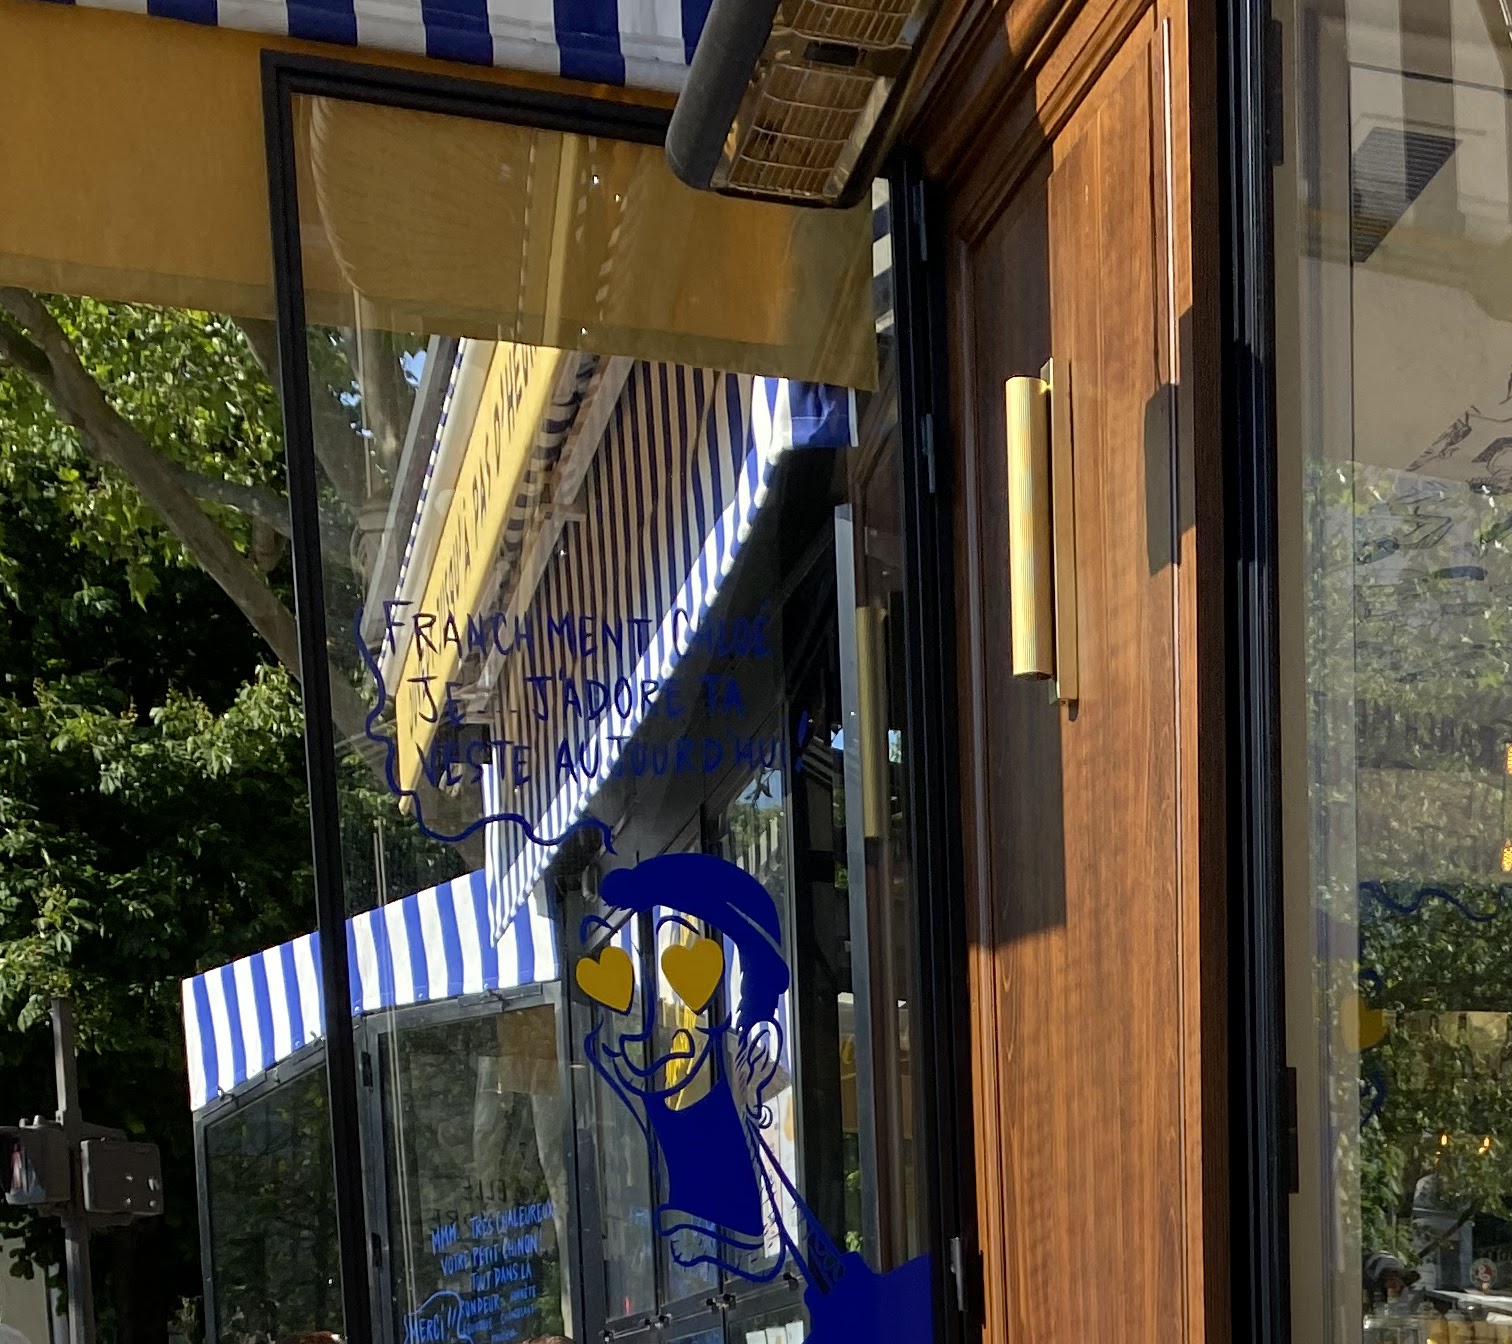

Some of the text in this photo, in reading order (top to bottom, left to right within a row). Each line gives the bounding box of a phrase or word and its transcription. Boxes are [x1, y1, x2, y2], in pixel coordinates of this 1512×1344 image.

[472, 432, 491, 549] PAS
[673, 599, 772, 659] CHLOÉ
[525, 665, 684, 722] J'ADORE
[700, 674, 746, 720] TA
[415, 739, 532, 788] VESTE
[493, 1262, 519, 1288] DANS
